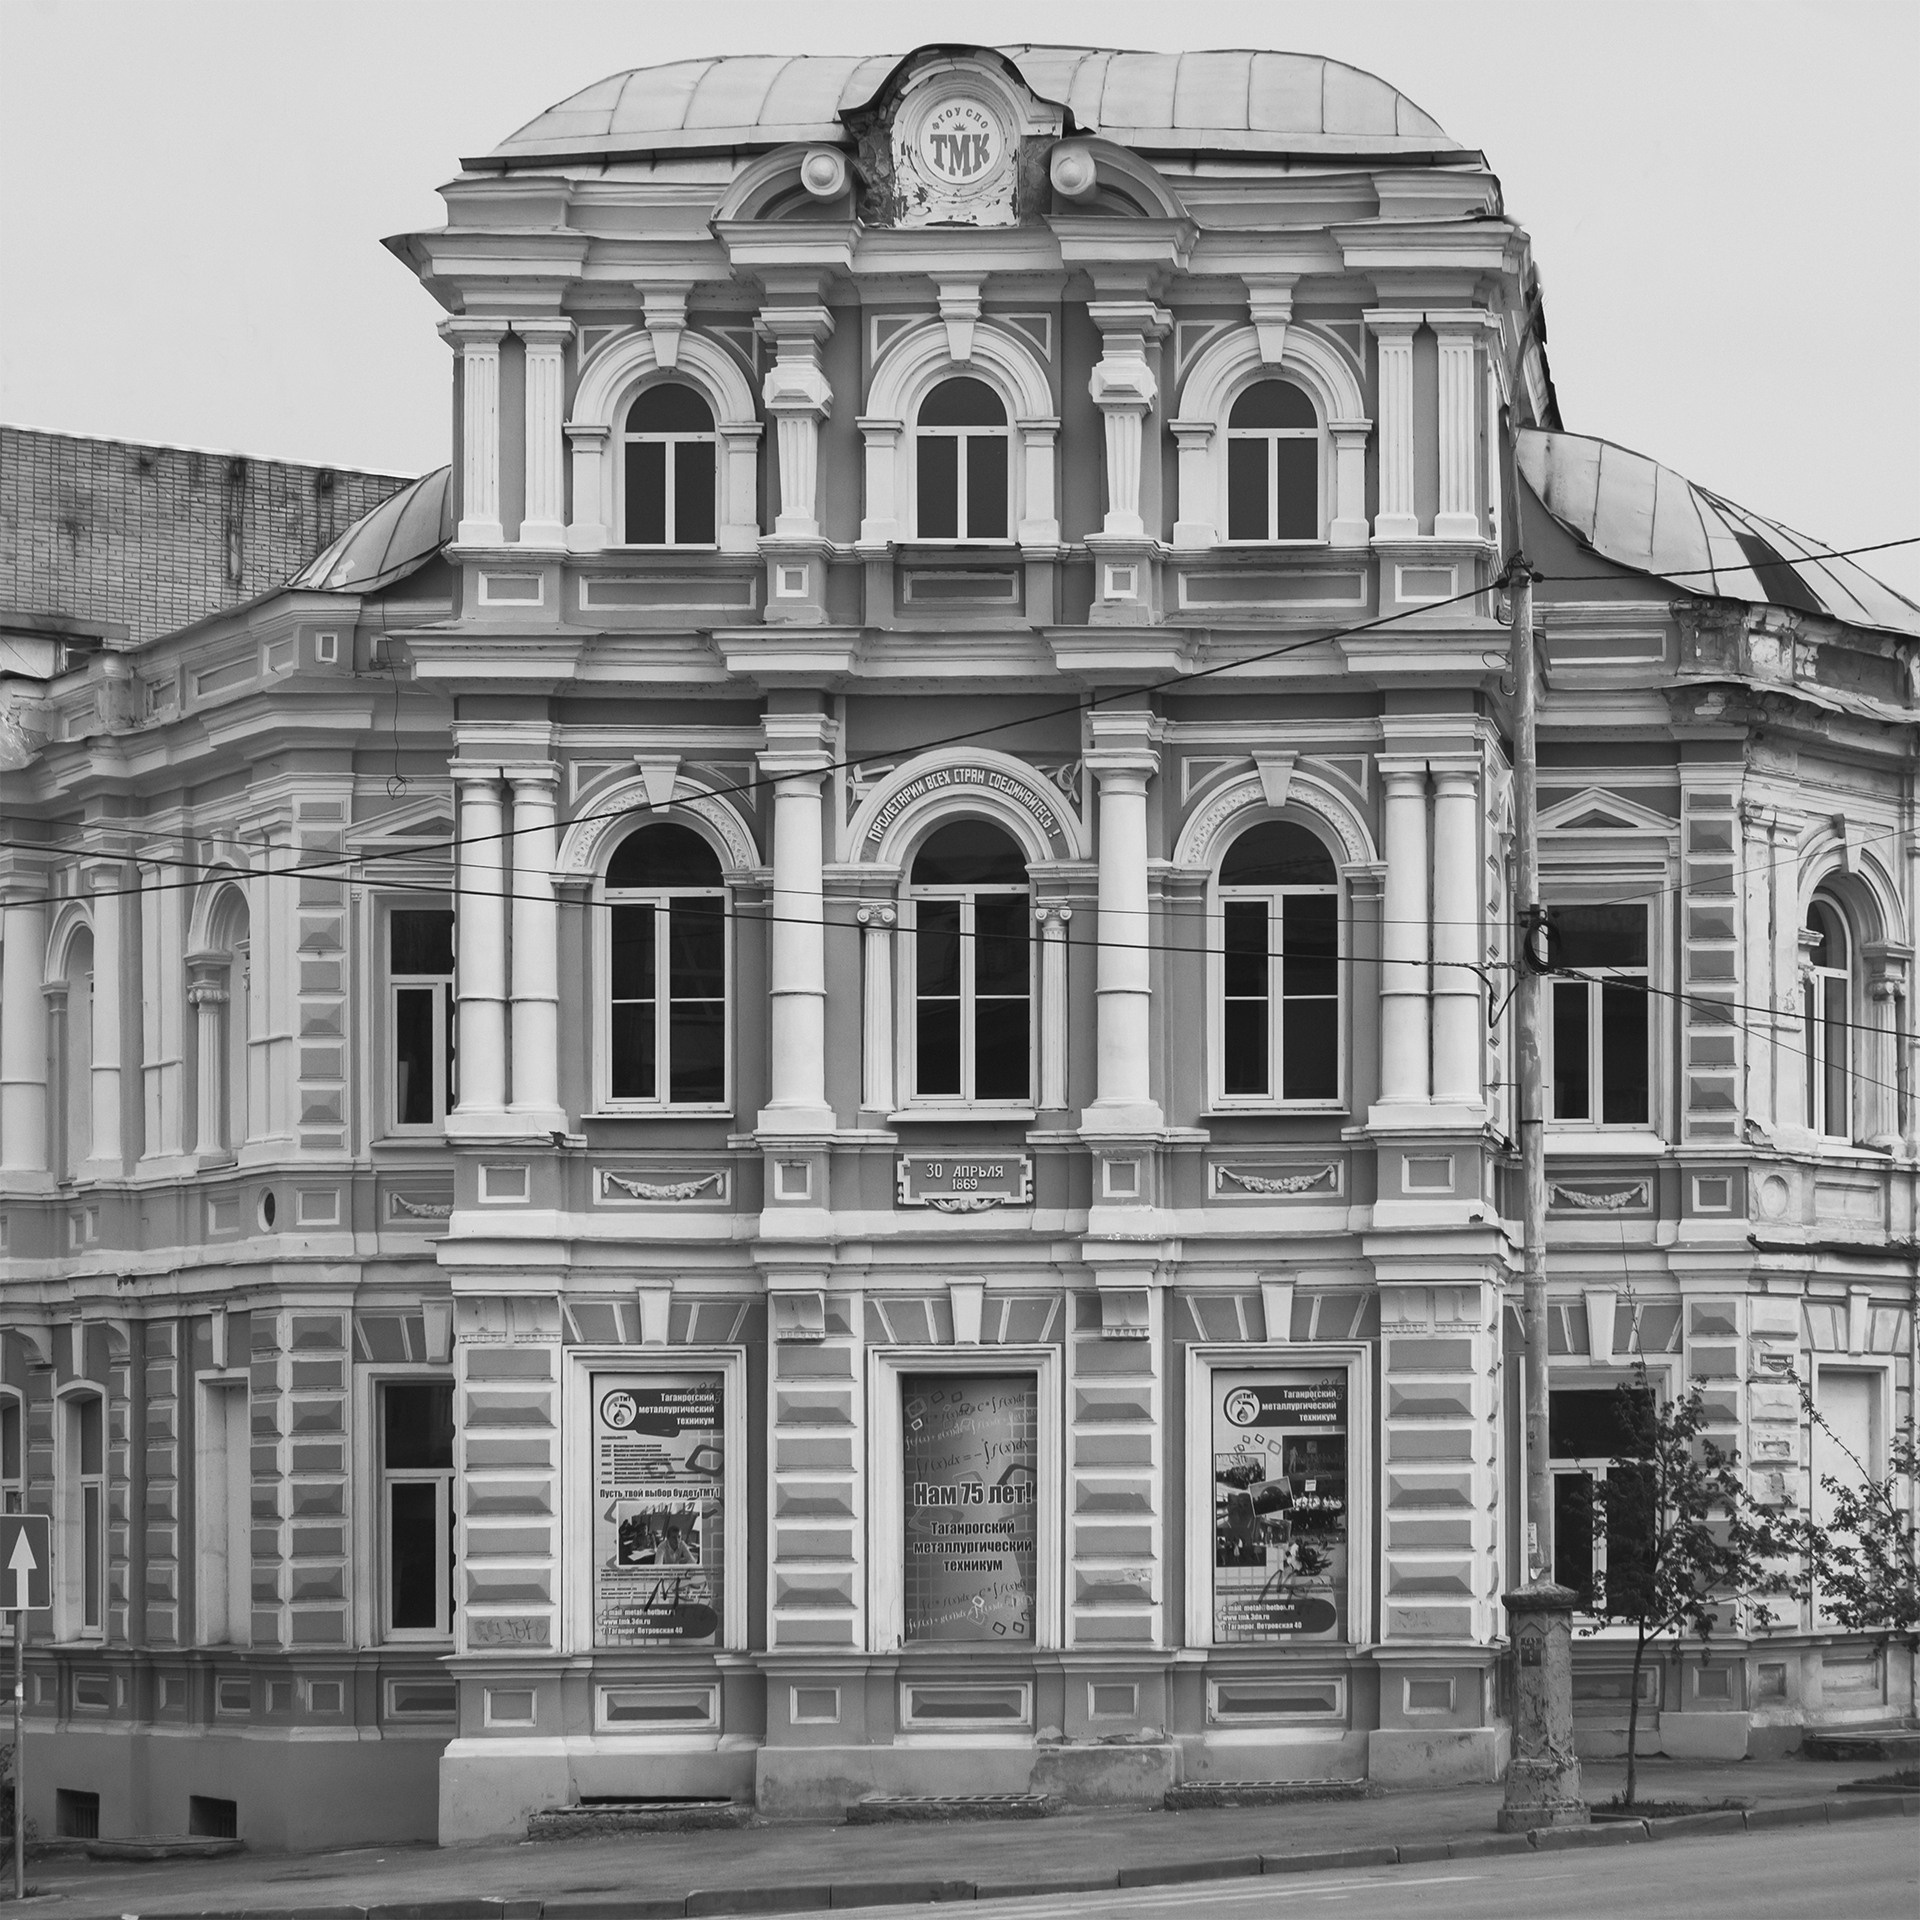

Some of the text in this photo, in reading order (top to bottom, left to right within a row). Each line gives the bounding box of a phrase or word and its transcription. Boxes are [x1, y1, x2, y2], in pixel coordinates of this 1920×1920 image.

[965, 108, 989, 129] СПО
[930, 133, 990, 177] ТМК
[867, 779, 926, 843] ПРОЛЕТАРИИ
[925, 770, 951, 790] ВСЕХ
[953, 768, 985, 784] СТРАН
[925, 1163, 943, 1178] 30
[952, 1178, 978, 1190] 1869
[660, 1392, 715, 1402] Таганрогский
[1283, 1389, 1337, 1399] Таганрогский
[638, 1404, 715, 1414] металлургический
[1261, 1400, 1337, 1411] металлургический
[676, 1416, 715, 1426] техникум
[1299, 1413, 1337, 1422] техникум
[599, 1488, 623, 1499] Пусть
[624, 1487, 644, 1498] твой
[645, 1488, 672, 1499] выбор
[913, 1480, 1033, 1506] Нам 75 лет!
[931, 1520, 1016, 1536] Таганрогский
[913, 1537, 1033, 1554] металлургический
[944, 1559, 1004, 1573] техникум
[675, 1625, 684, 1635] 40
[1294, 1620, 1303, 1630] 40
